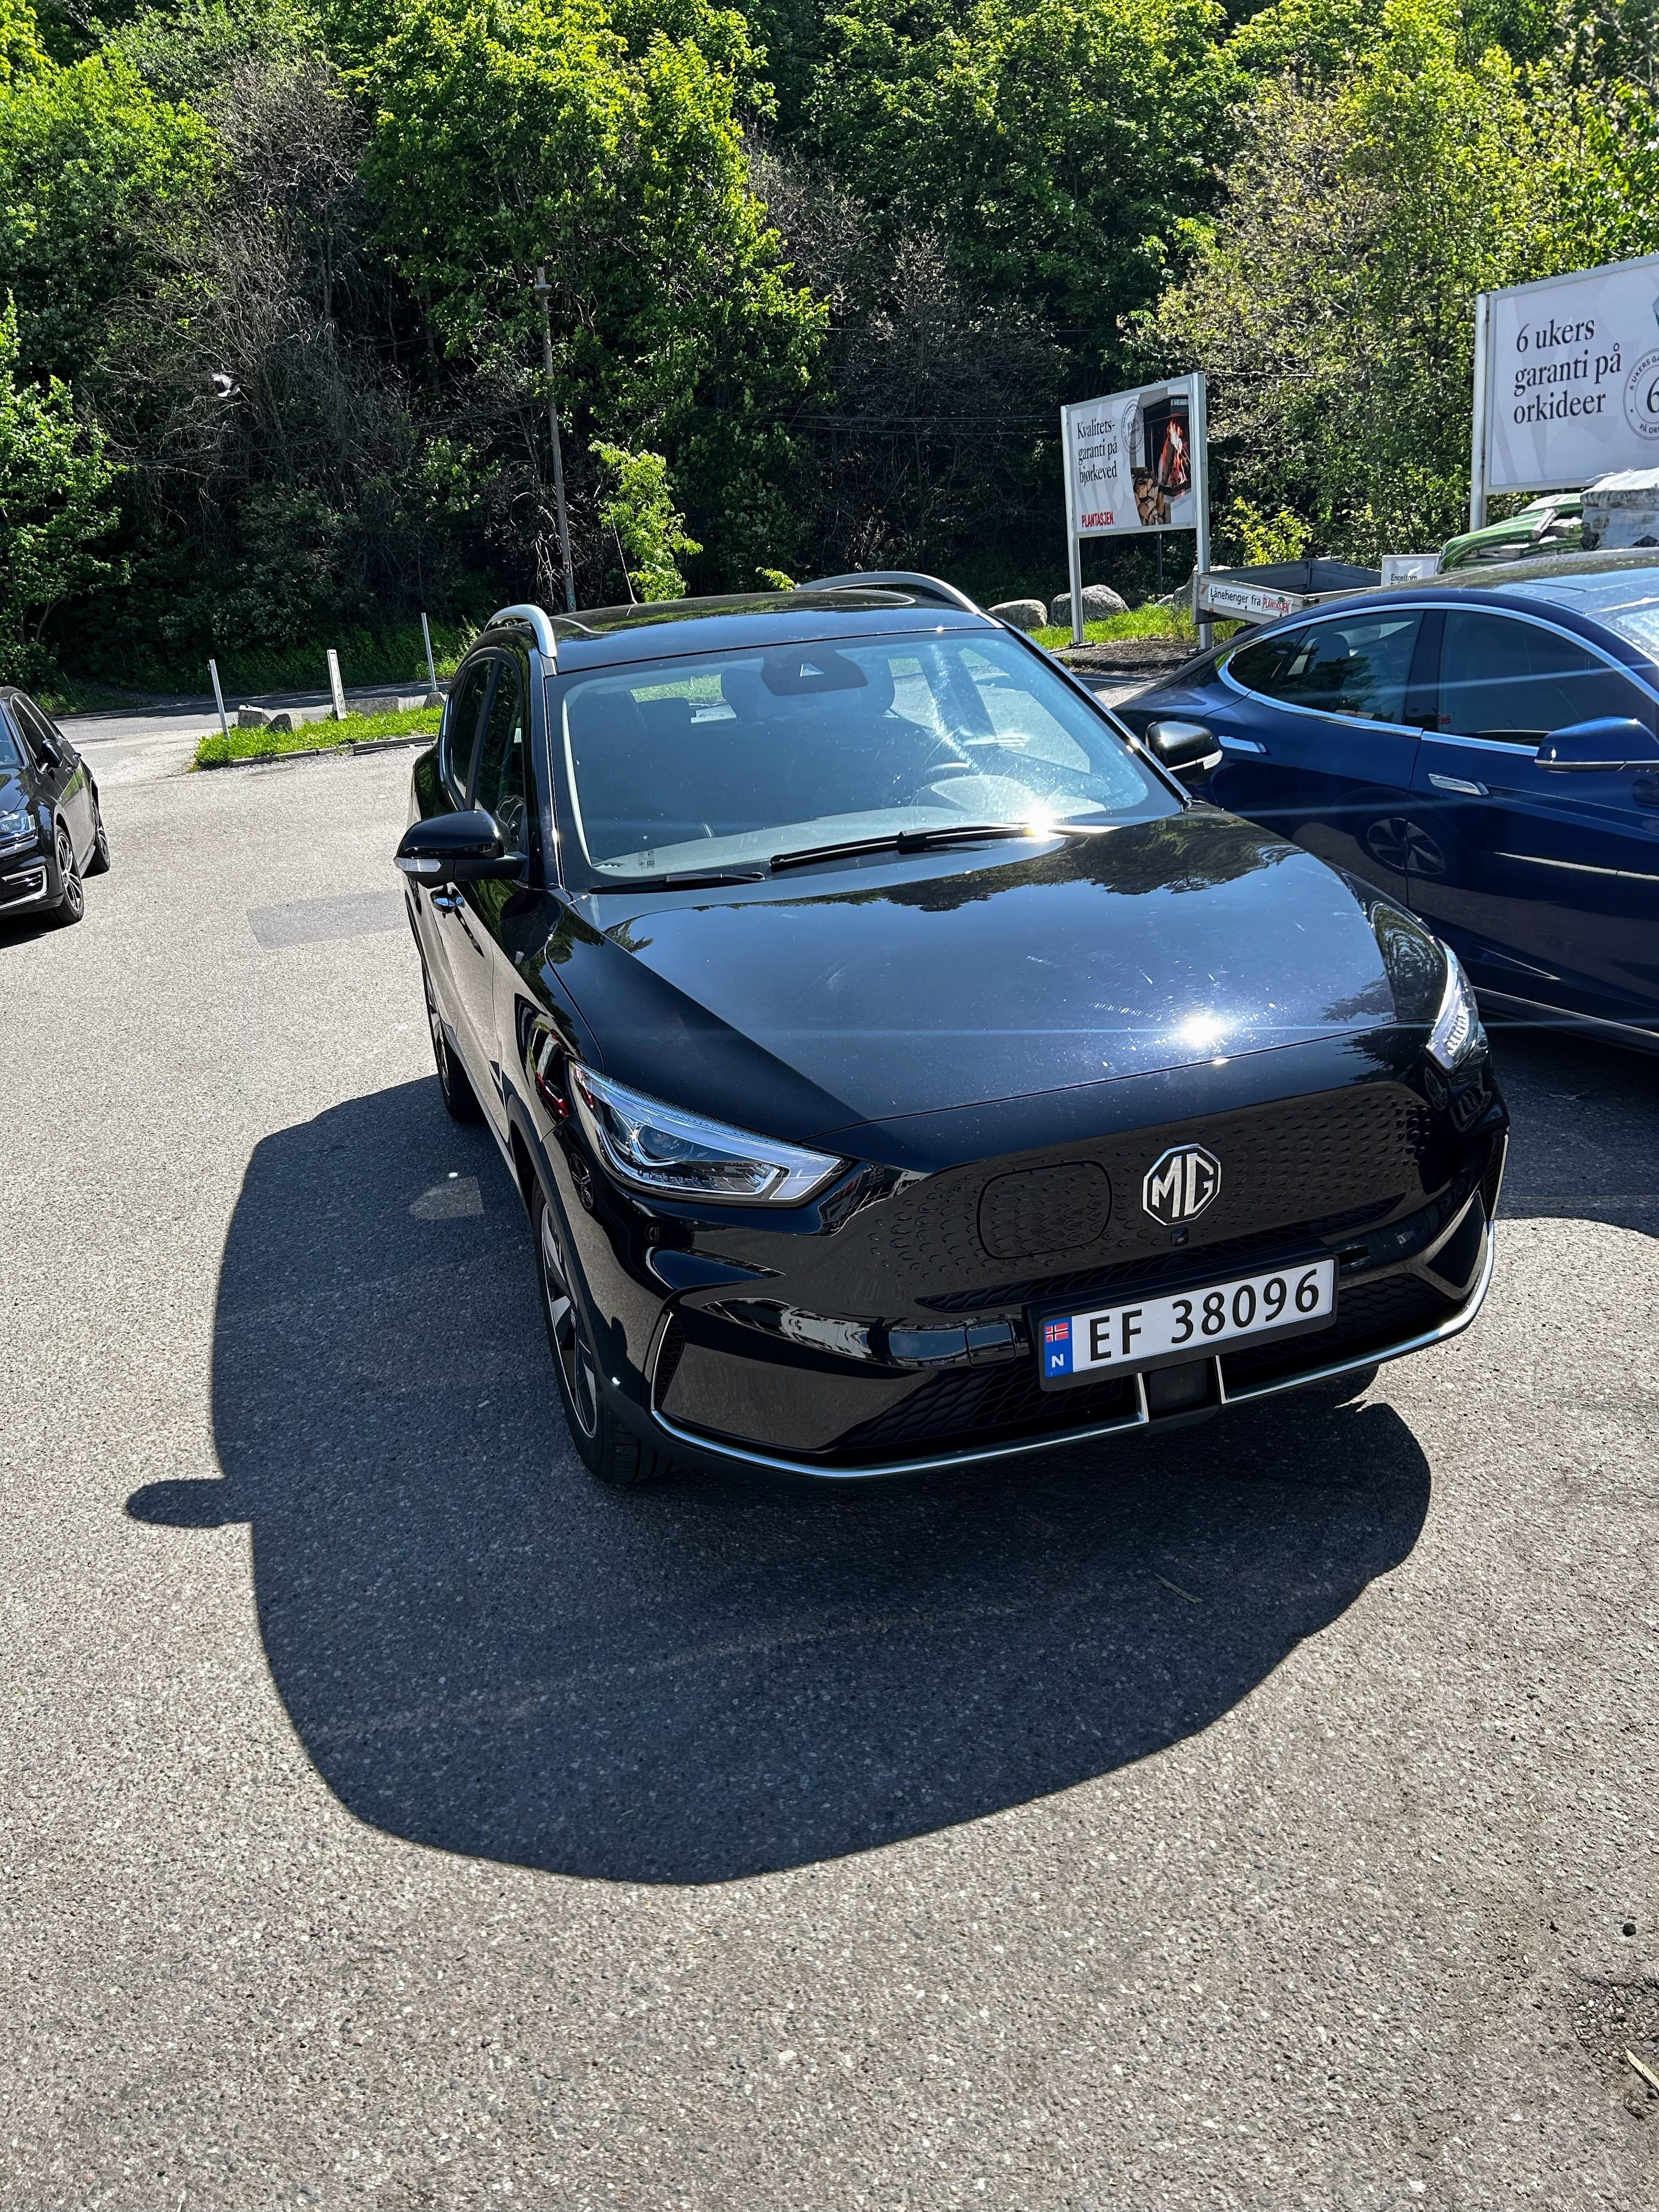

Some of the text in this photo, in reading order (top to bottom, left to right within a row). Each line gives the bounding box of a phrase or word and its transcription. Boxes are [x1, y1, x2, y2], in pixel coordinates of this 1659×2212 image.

[1516, 318, 1595, 353] 6 ukers
[1514, 342, 1622, 397] garanti på
[1631, 358, 1650, 382] UKERS
[1513, 389, 1606, 425] orkideer
[1077, 418, 1115, 439] Kvalitets-
[1078, 436, 1118, 465] garanti på
[1079, 461, 1118, 487] bjørkeved
[1210, 587, 1261, 606] Lånehenger fra
[1152, 1152, 1214, 1218] MG
[1089, 1268, 1319, 1362] EF 38096
[1051, 1353, 1064, 1368] N
